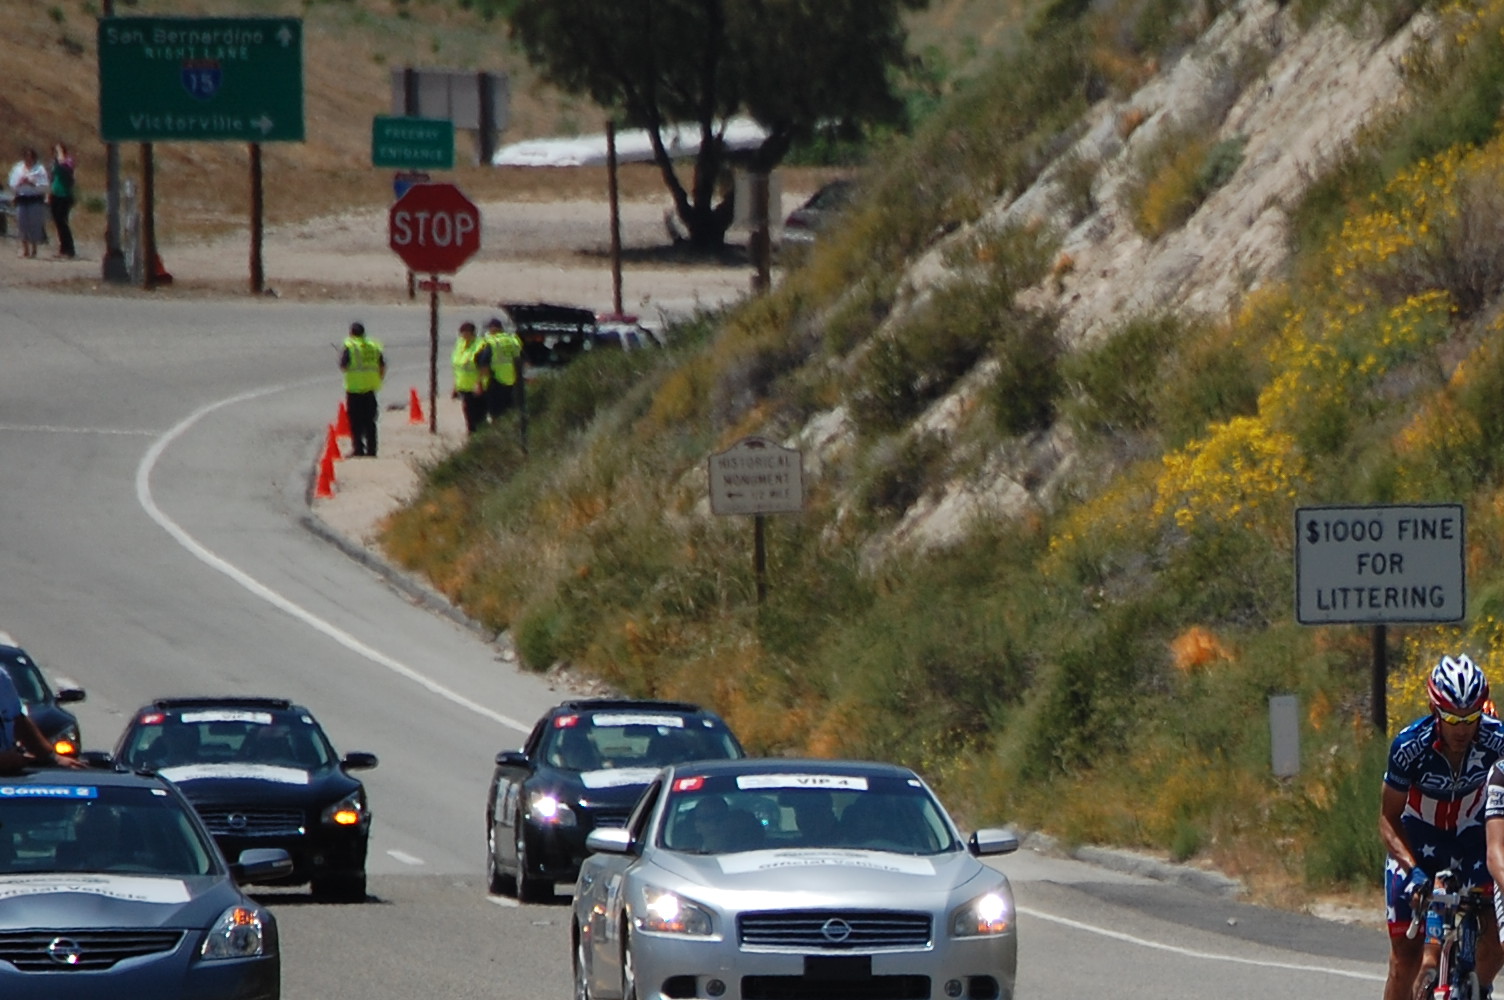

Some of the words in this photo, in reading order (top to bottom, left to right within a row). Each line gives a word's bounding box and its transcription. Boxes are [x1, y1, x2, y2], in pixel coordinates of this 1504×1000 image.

[107, 28, 143, 44] San
[154, 28, 264, 44] Bernardino
[144, 47, 196, 60] RIGHT
[205, 45, 249, 60] LANE
[190, 73, 214, 93] 15
[129, 114, 243, 131] Victorville
[394, 211, 474, 247] STOP
[1306, 520, 1383, 544] $1000
[1398, 519, 1454, 541] FINE
[1357, 553, 1403, 575] FOR
[1317, 585, 1445, 611] LITTERING
[76, 787, 90, 796] 2
[834, 860, 901, 872] Vehicle
[67, 886, 148, 900] Vehicle
